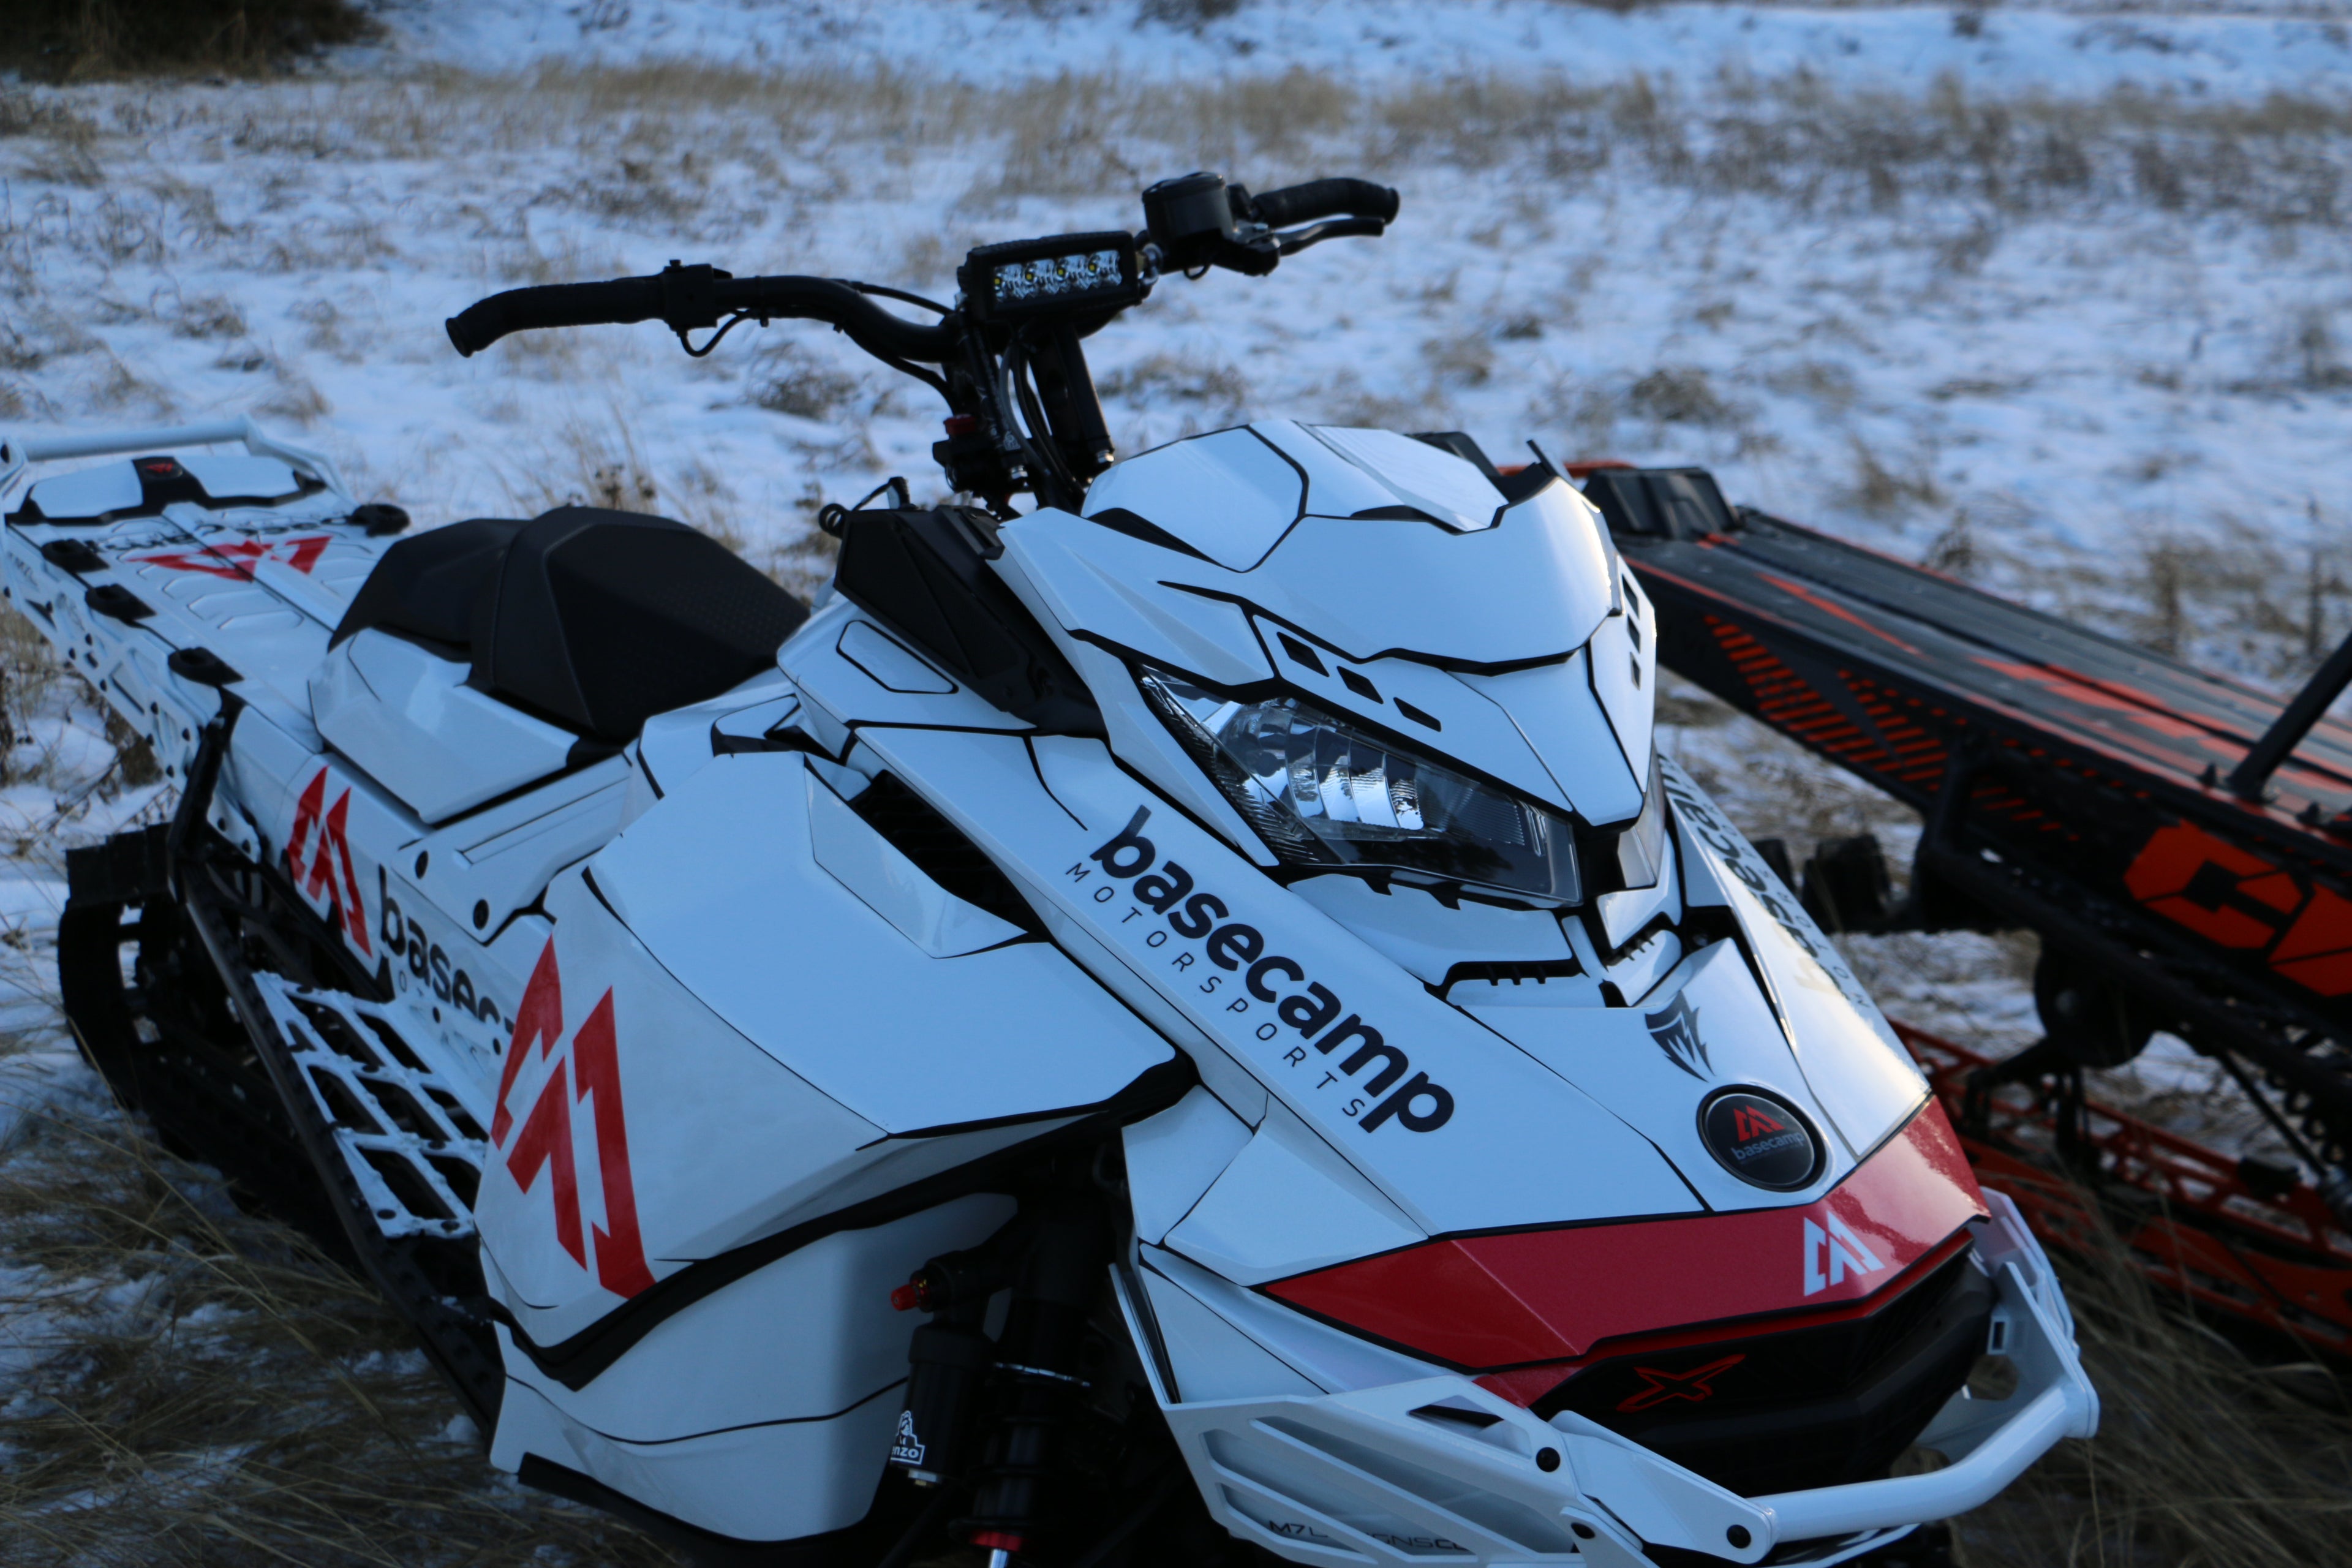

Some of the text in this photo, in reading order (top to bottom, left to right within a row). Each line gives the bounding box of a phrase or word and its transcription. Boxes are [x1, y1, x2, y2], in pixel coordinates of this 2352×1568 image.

[1065, 862, 1366, 1118] MOTORSPORTS
[1089, 804, 1455, 1134] basecamp
[1730, 1132, 1805, 1161] basecamp
